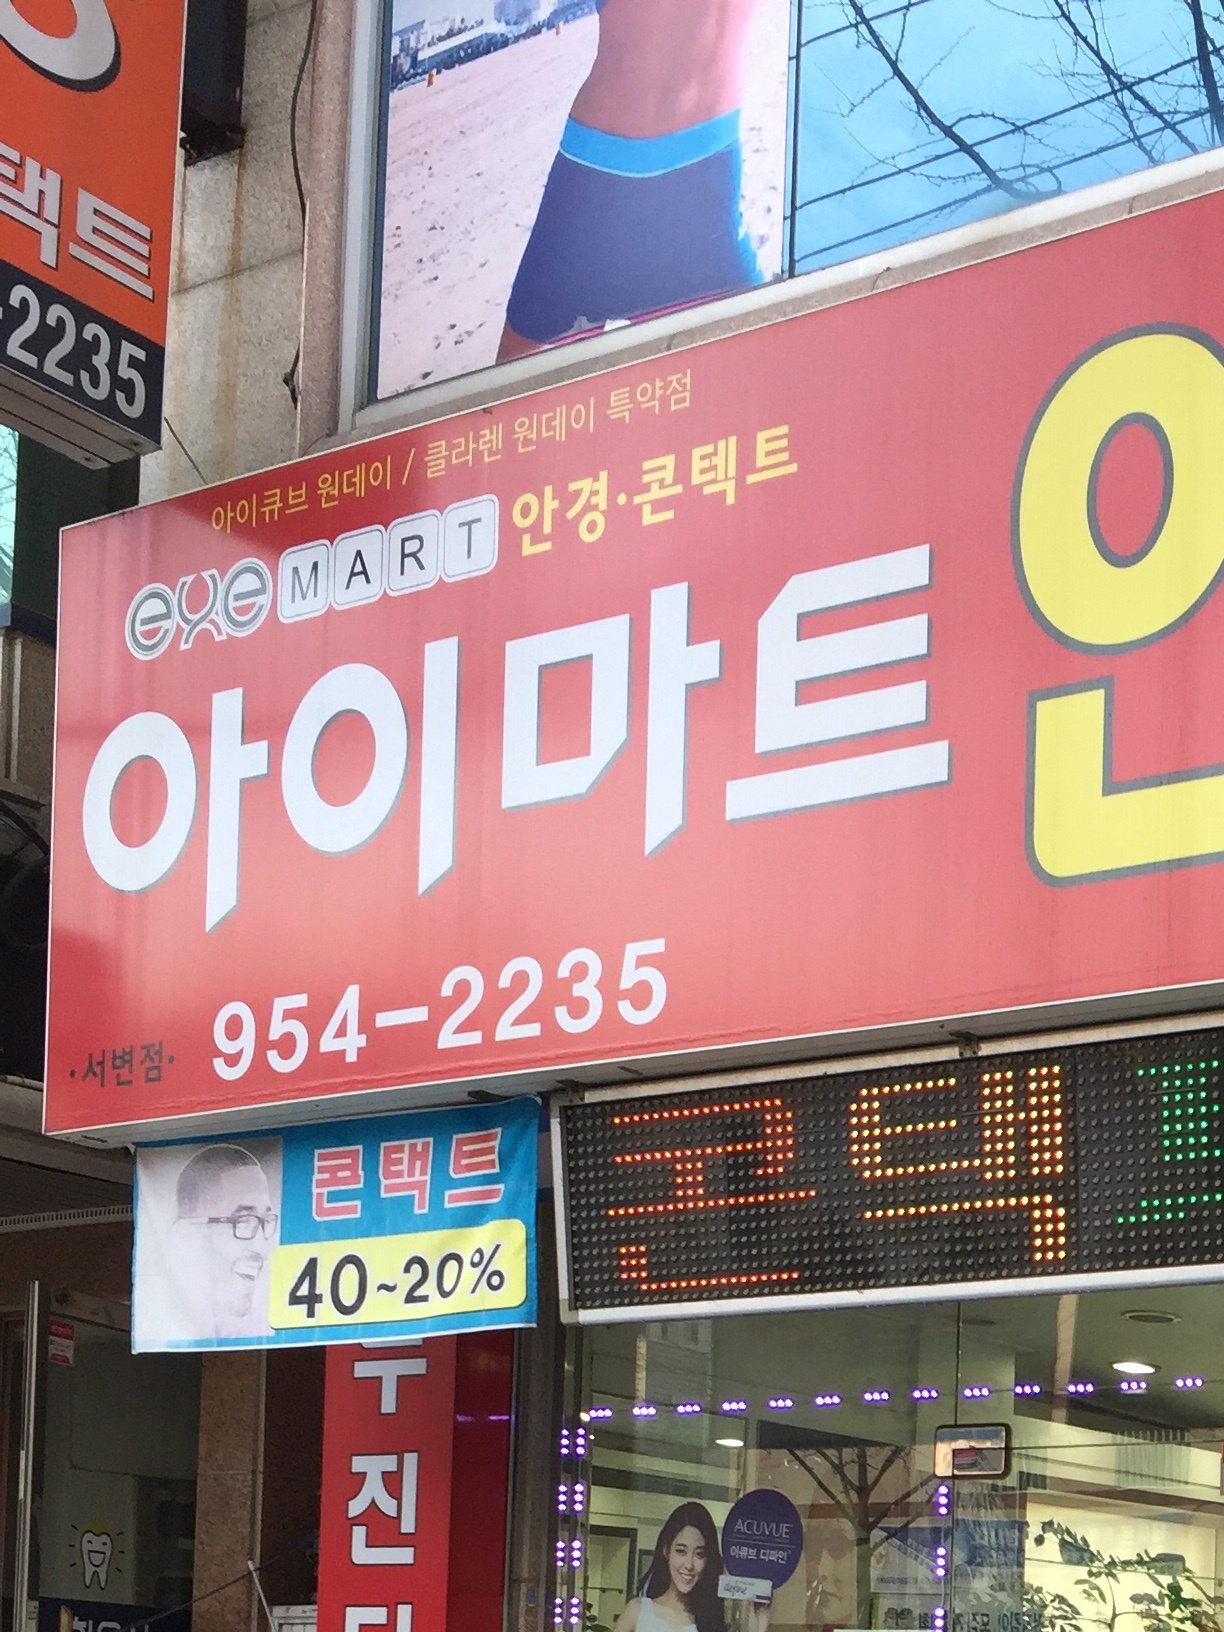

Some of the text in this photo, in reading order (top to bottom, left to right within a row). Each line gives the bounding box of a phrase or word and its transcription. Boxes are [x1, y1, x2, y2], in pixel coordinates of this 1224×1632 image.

[211, 480, 310, 534] 아이큐브
[317, 455, 393, 508] 원데이
[425, 421, 502, 475] 클라렌
[513, 396, 595, 452] 원데이
[606, 370, 692, 422] 특약점
[283, 508, 492, 612] MART
[83, 543, 950, 933] 아이마트
[212, 938, 669, 1081] 954-2235
[311, 1128, 505, 1223] 콘택트
[287, 1243, 505, 1319] 40~20%
[730, 1545, 758, 1560] 아큐브
[734, 1519, 792, 1539] ACUVUE
